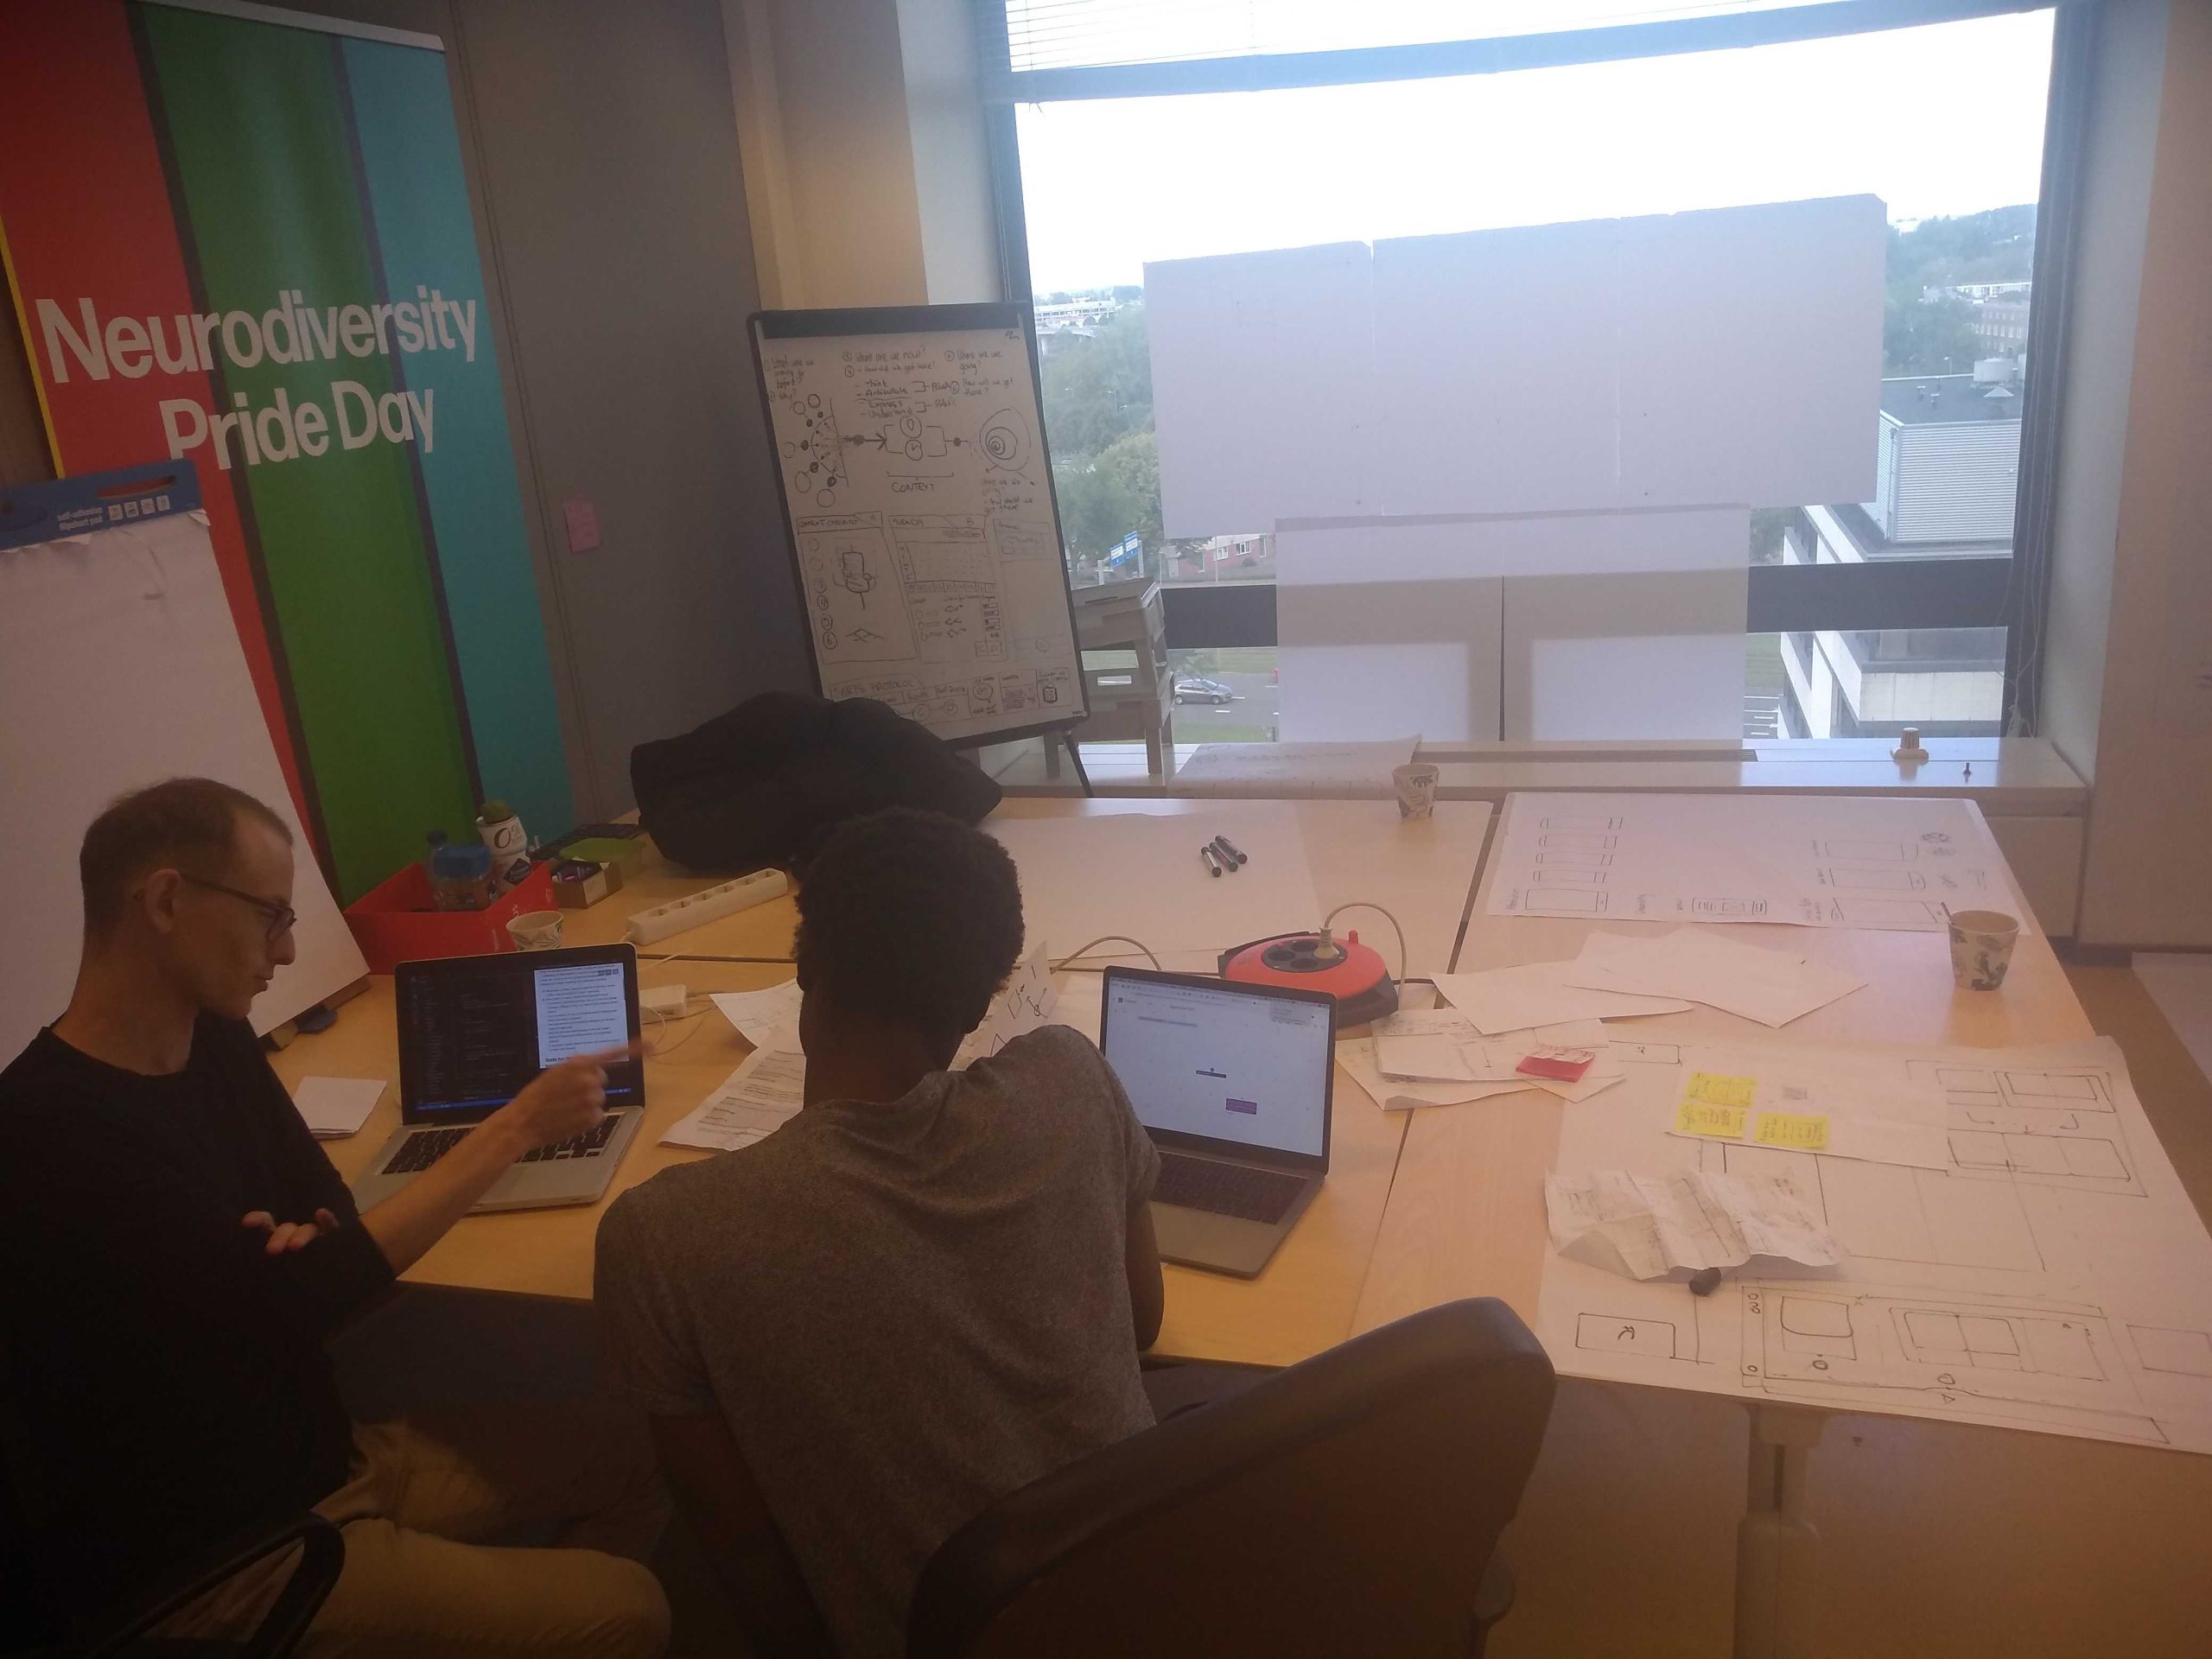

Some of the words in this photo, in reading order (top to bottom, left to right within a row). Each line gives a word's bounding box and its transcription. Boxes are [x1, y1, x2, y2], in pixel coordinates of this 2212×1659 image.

[36, 285, 476, 383] Neurodiversity
[159, 388, 330, 470] Pride
[331, 380, 435, 454] Day
[891, 482, 936, 493] CONTEXT
